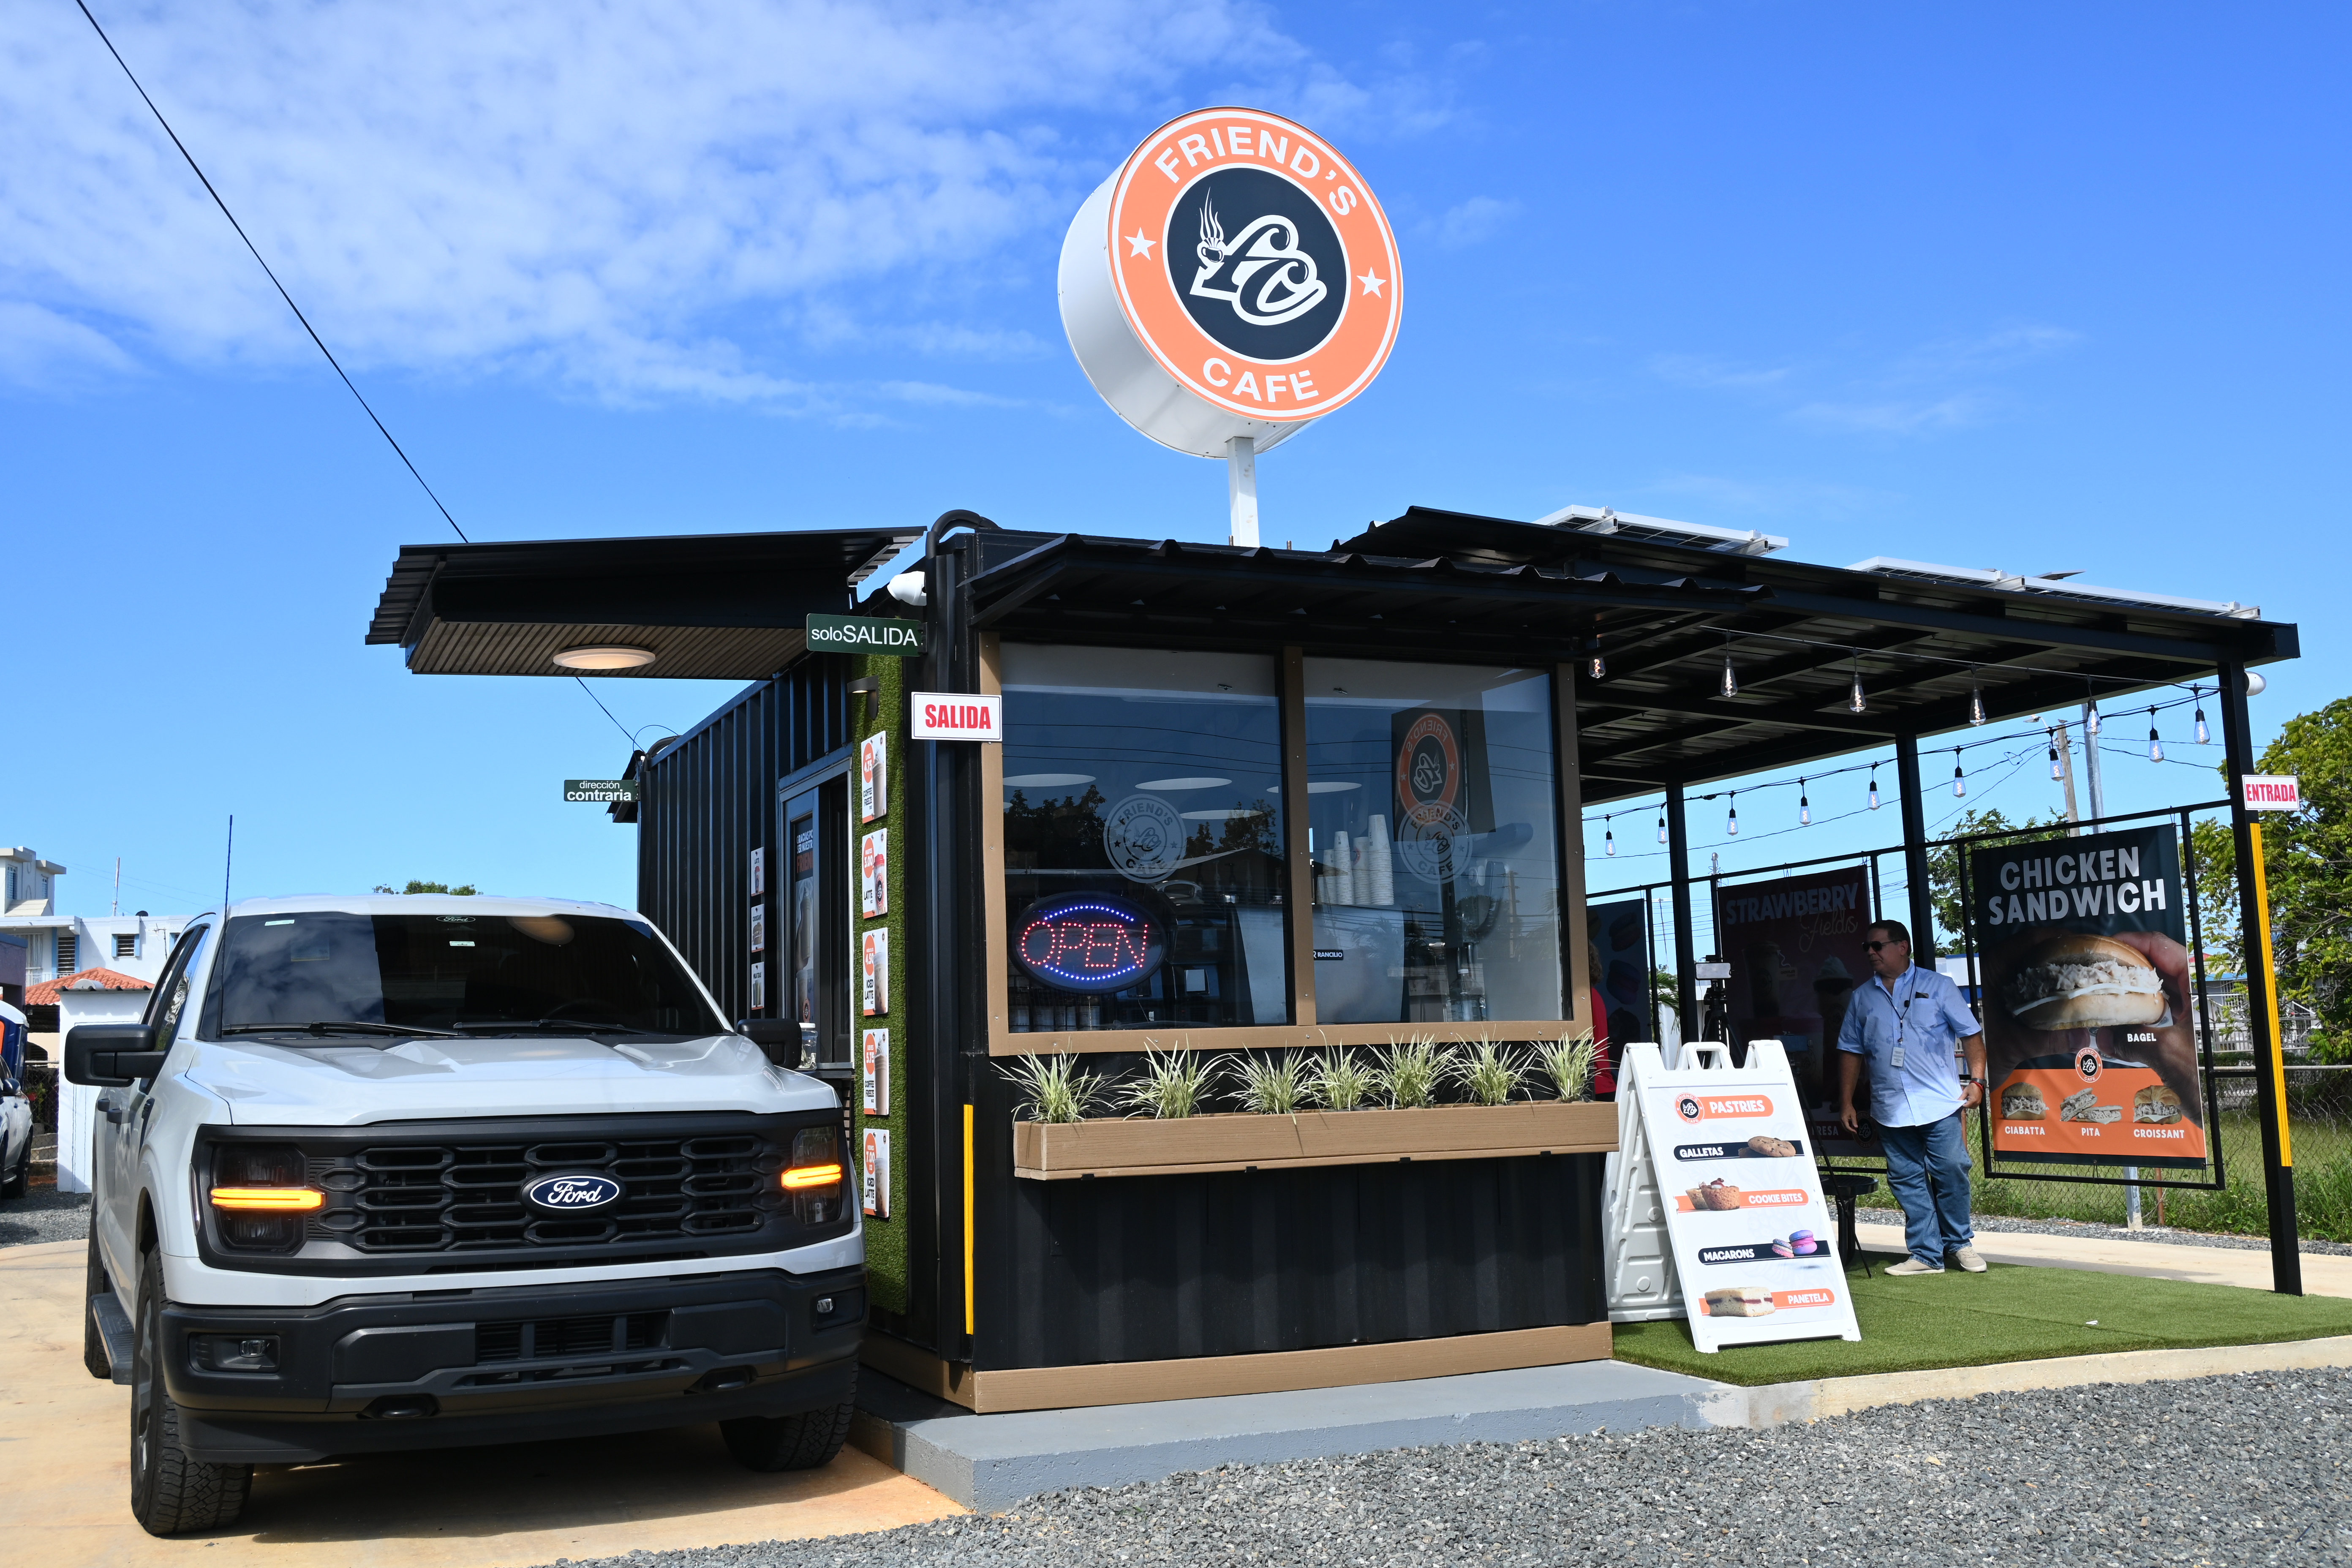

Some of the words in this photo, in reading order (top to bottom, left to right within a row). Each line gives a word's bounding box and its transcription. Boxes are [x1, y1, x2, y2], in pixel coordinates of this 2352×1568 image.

[1154, 126, 1357, 216] FRIEND'S
[925, 704, 991, 729] SALIDA
[579, 781, 620, 789] dirección
[567, 789, 632, 801] contraria
[863, 787, 872, 798] COFFEE
[2246, 784, 2297, 802] ENTRADA
[1117, 803, 1173, 826] FRIEND'S
[796, 831, 809, 844] GRACIAS
[802, 839, 813, 852] NUESTR
[797, 850, 814, 874] FRIEN
[864, 855, 873, 868] 3.00
[2000, 846, 2140, 891] CHICKEN
[864, 889, 873, 900] LATTE
[1726, 883, 1859, 925] STRAWBERRY
[1989, 878, 2166, 925] SANDWICH
[1799, 907, 1858, 953] Fields
[1022, 921, 1148, 967] OPEN
[864, 990, 874, 1000] LATTE
[2127, 1033, 2156, 1042] BAGEL
[2078, 1049, 2098, 1058] FRIEND'S
[1677, 1094, 1698, 1102] FRIEND'S
[1709, 1100, 1765, 1113] PASTRIES
[2004, 1126, 2045, 1135] CIABATTA
[2081, 1127, 2100, 1136] PITA
[2133, 1129, 2185, 1139] CROISSANT
[866, 1152, 875, 1164] 7.00
[1679, 1146, 1724, 1158] GALLETAS
[548, 1181, 603, 1203] Ford
[865, 1188, 874, 1199] LATTE
[1748, 1195, 1781, 1204] COOKIE
[1782, 1193, 1803, 1203] BITES
[1703, 1248, 1755, 1262] MACARONS
[1788, 1293, 1829, 1304] PANETELA
